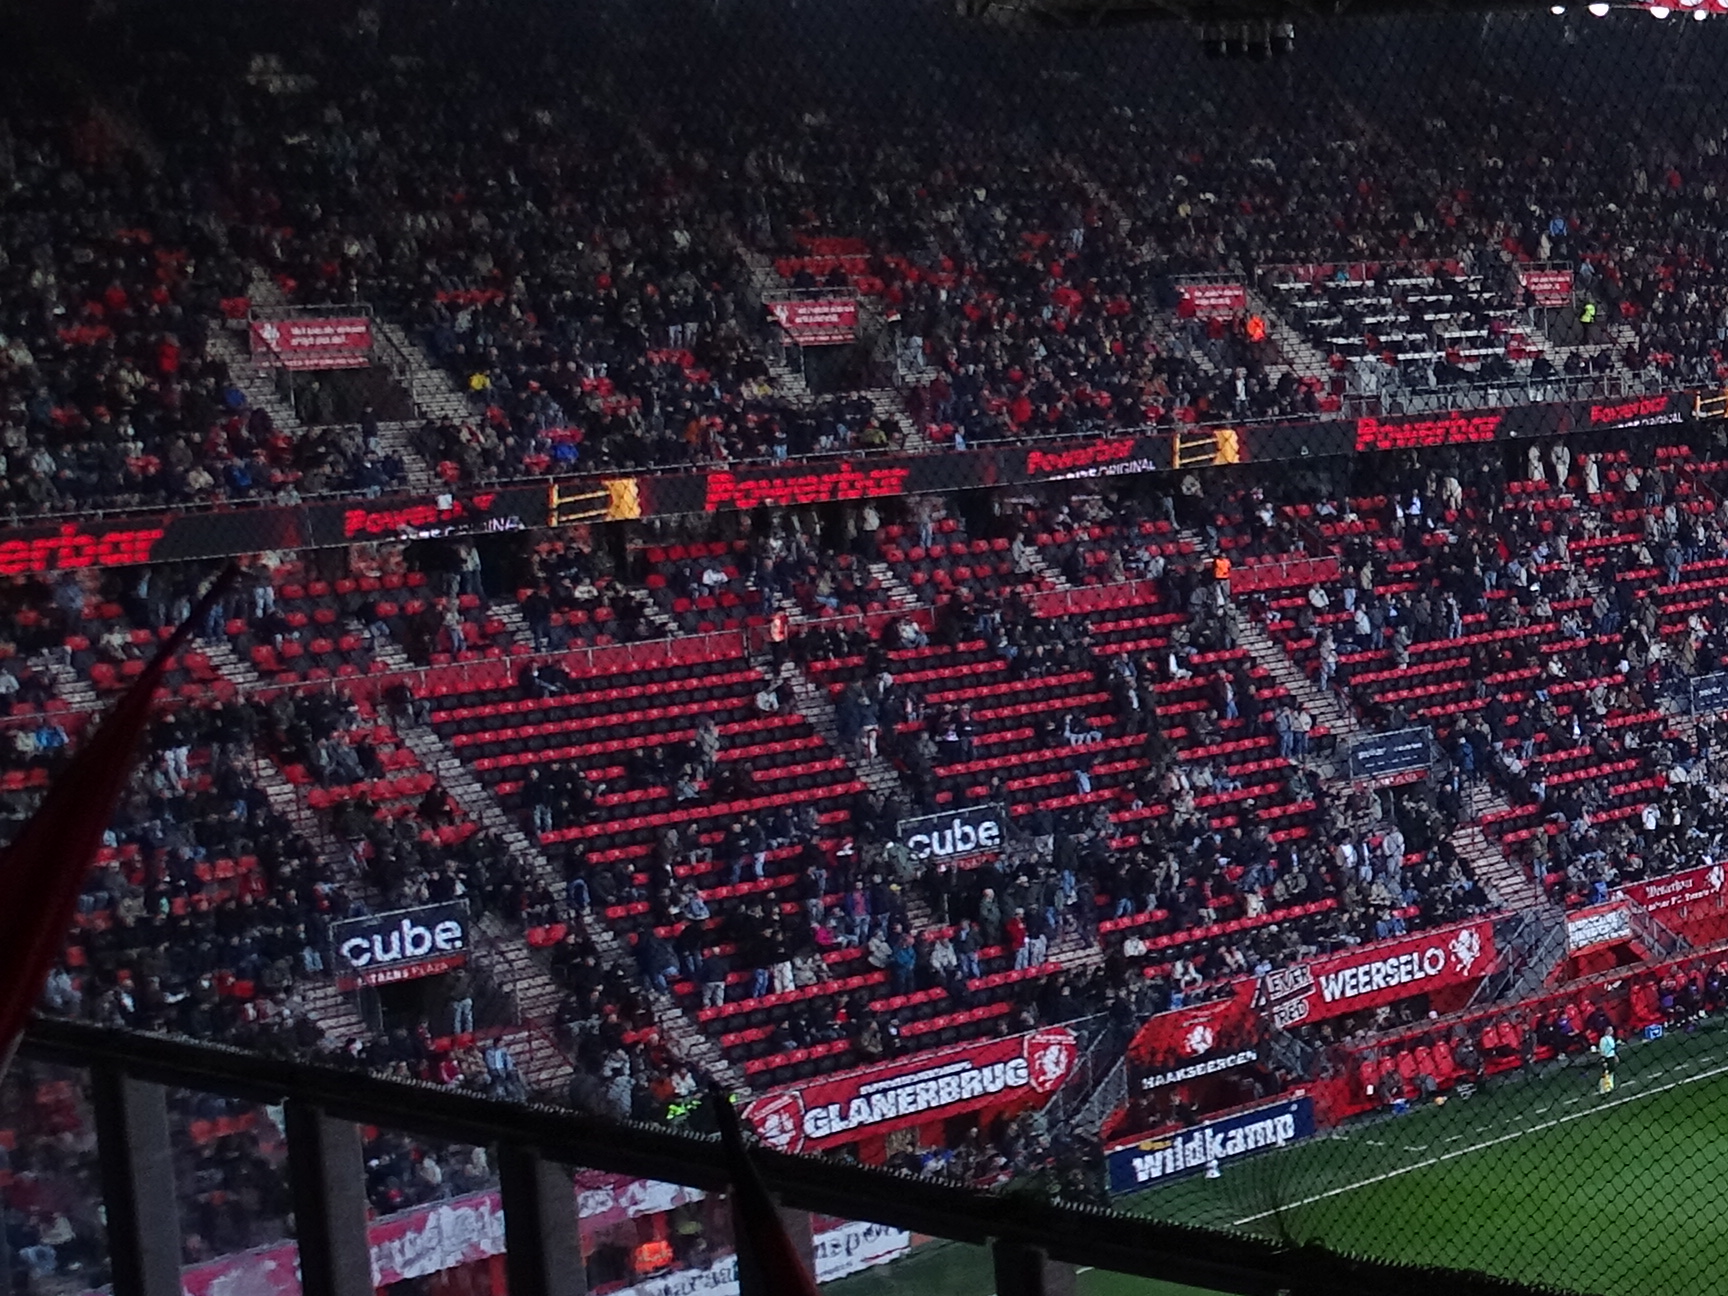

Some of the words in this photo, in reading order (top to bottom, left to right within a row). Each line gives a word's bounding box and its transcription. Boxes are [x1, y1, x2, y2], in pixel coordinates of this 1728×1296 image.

[706, 462, 910, 513] Powerbar
[1319, 948, 1446, 1002] WEERSELO
[803, 1058, 1029, 1140] GLANERBRUG
[1131, 1114, 1296, 1183] wildkamp
